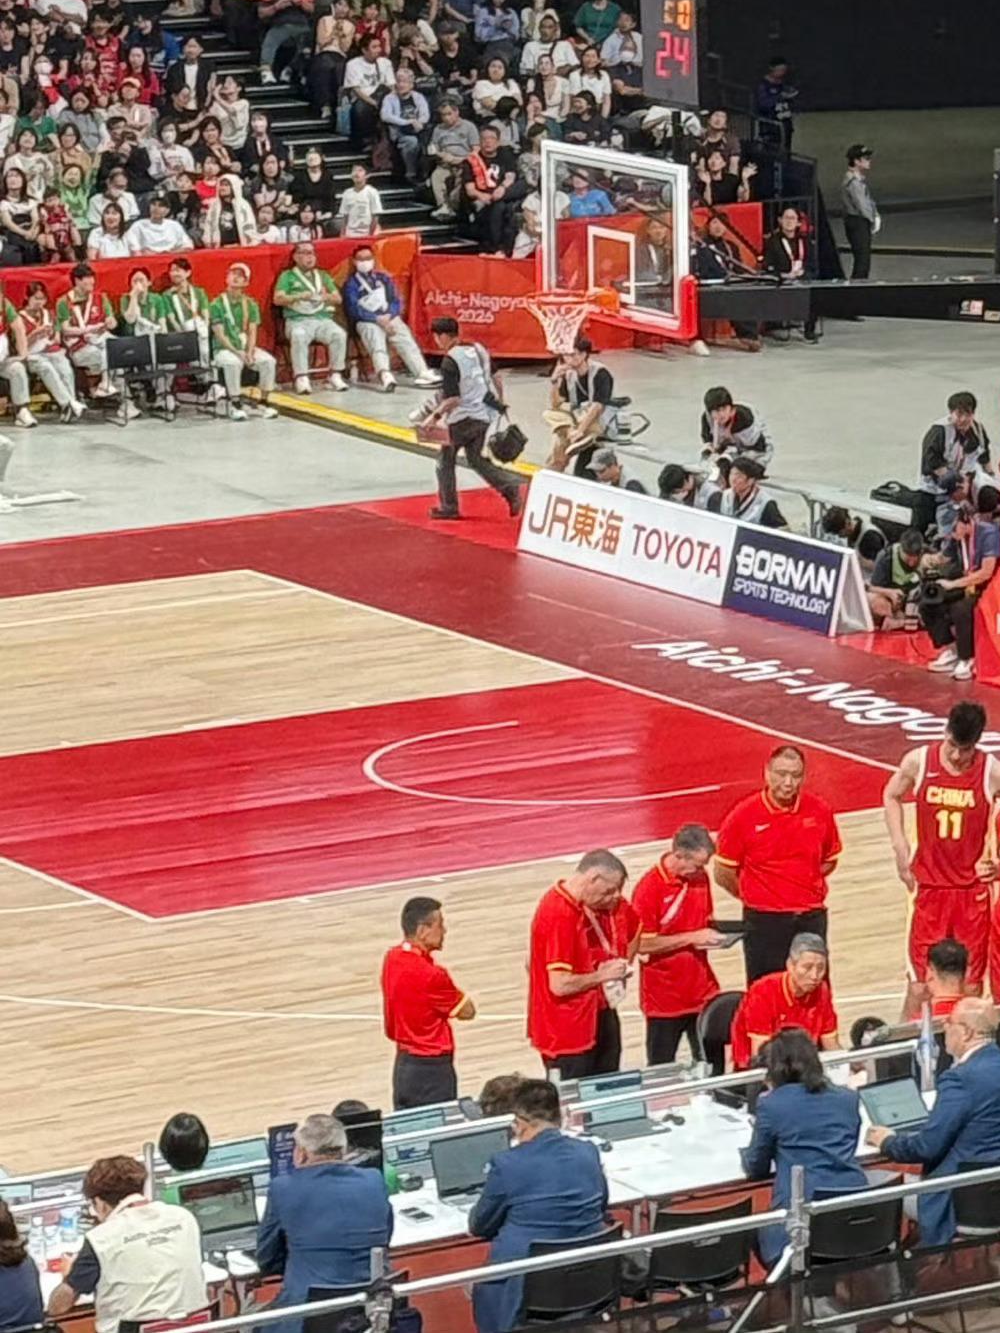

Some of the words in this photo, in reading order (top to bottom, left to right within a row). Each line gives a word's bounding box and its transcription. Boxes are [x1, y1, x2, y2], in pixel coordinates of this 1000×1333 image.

[656, 30, 691, 78] 24
[425, 290, 528, 311] Aichi-Nagoya
[457, 308, 494, 324] 2026
[528, 493, 623, 555] JR東海
[631, 523, 722, 578] TOYOTA
[736, 545, 836, 599] BORNAN
[733, 579, 768, 601] SPORTS
[769, 587, 830, 615] TECHNOLOGY
[926, 786, 976, 808] CHINA
[936, 810, 963, 840] 11
